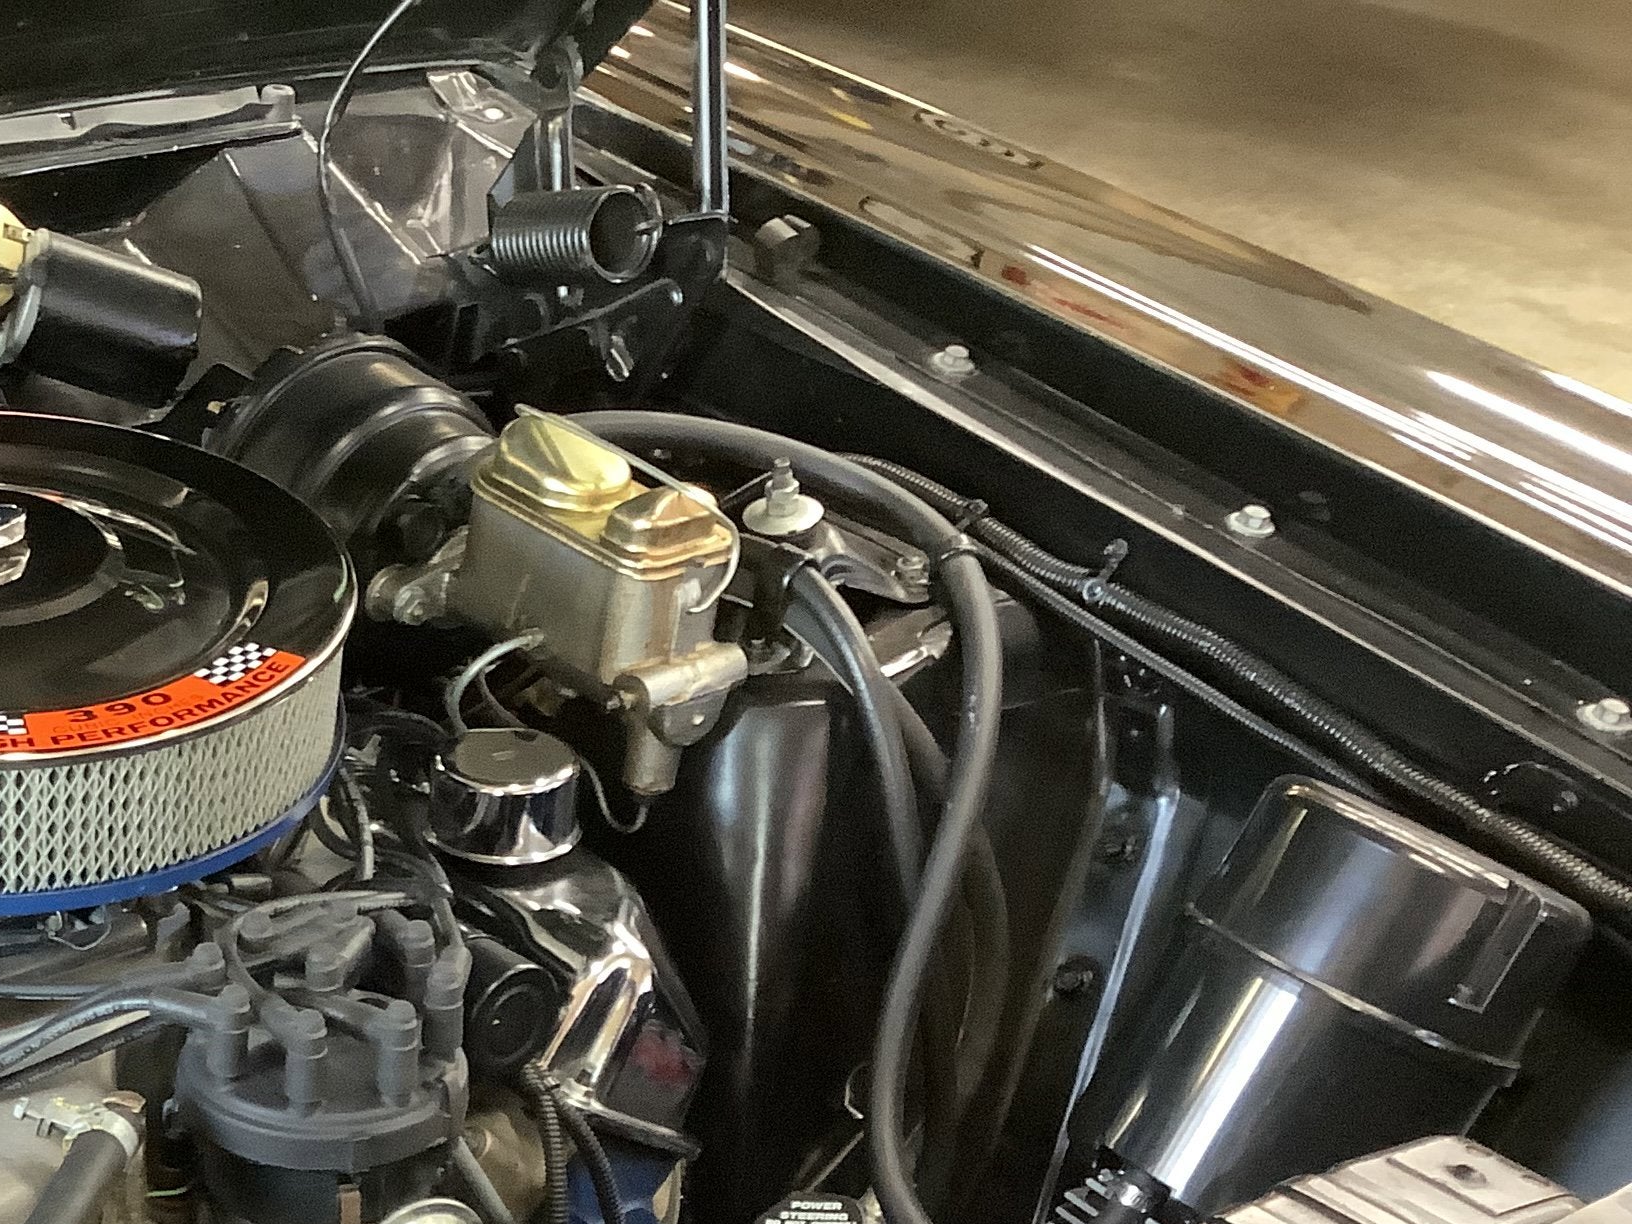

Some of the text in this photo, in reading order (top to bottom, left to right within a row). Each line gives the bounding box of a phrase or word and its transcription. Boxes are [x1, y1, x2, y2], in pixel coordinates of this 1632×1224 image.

[51, 660, 288, 746] PERFORMANCE
[65, 692, 172, 723] 390
[779, 1211, 849, 1221] STEERING
[790, 1201, 843, 1211] POWER
